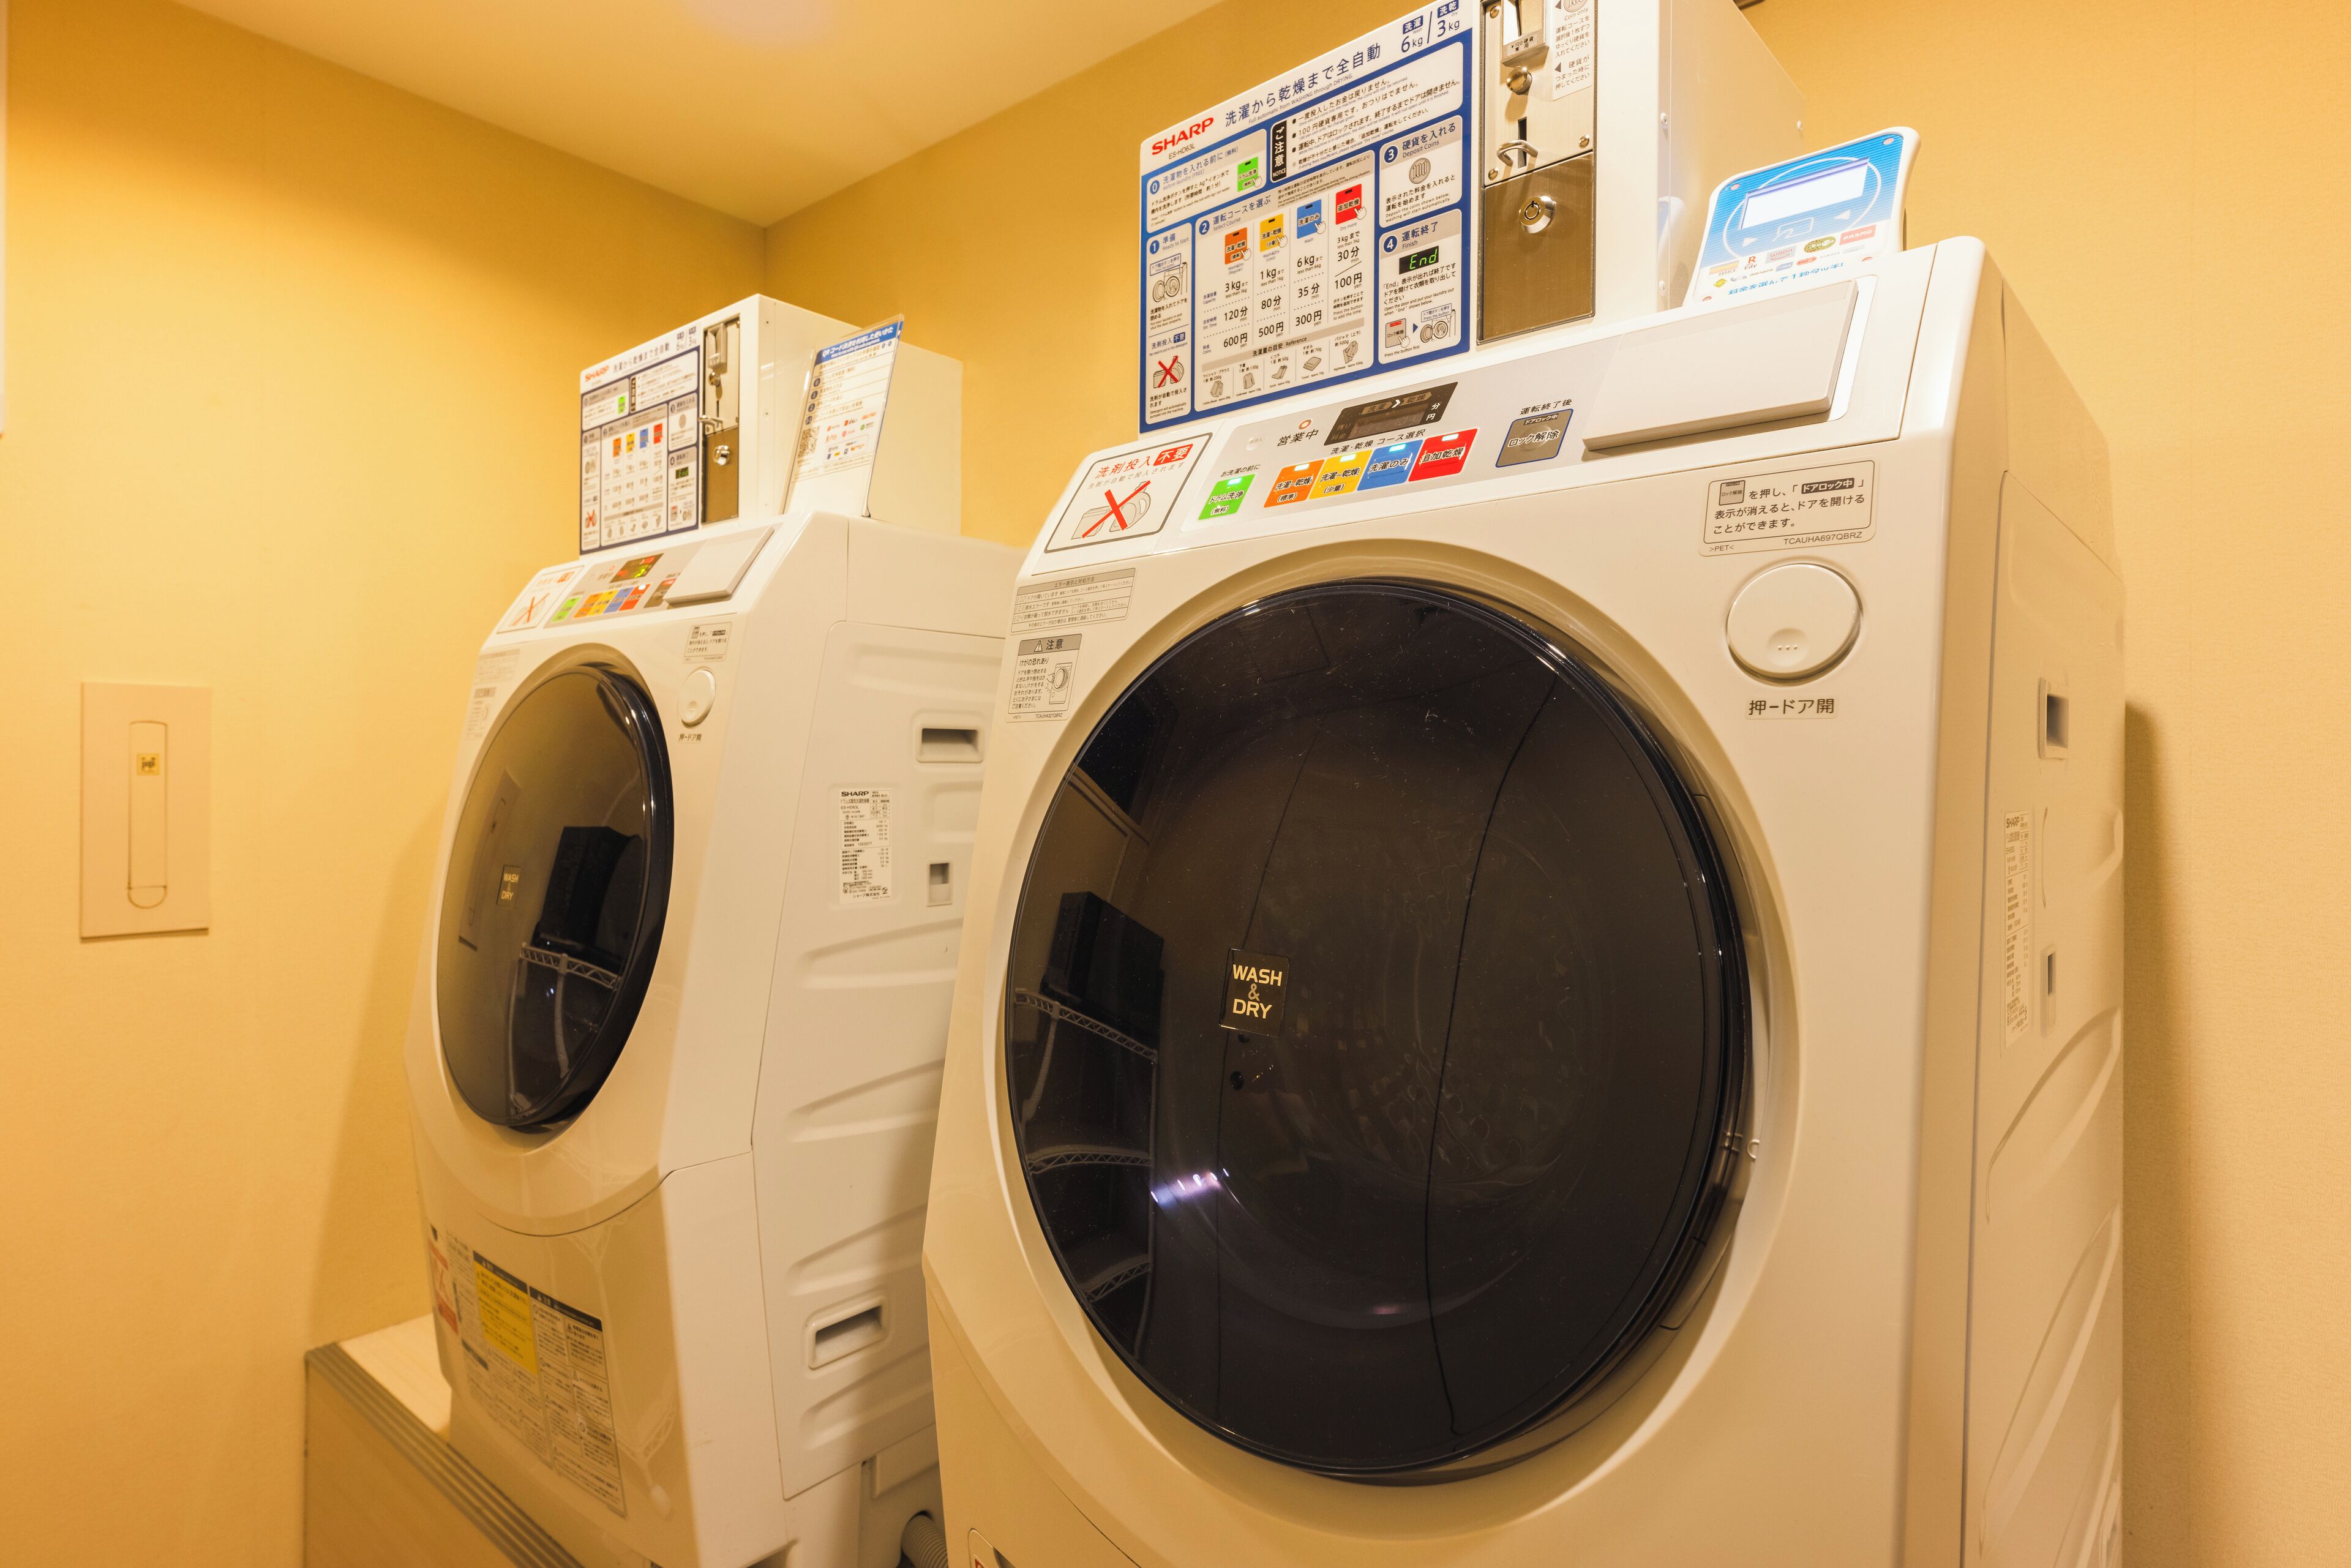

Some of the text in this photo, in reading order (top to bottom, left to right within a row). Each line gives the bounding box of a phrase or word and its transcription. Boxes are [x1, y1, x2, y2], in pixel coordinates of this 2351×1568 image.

[1577, 7, 1589, 16] only
[1404, 17, 1422, 32] 洗濯
[1556, 15, 1590, 33] 運転コースを
[1556, 40, 1590, 58] 入れてください
[1569, 54, 1590, 69] 硬貨が
[1555, 73, 1590, 90] 押してください
[1556, 65, 1590, 81] つまった時に
[1225, 43, 1381, 127] 洗濯から乾燥まで全自動
[1256, 108, 1279, 122] automatic
[1279, 102, 1291, 111] from
[1291, 92, 1313, 105] WASHING
[1314, 84, 1333, 98] through
[1152, 117, 1214, 155] SHARP
[1402, 122, 1456, 151] 硬貨を入れる
[1169, 143, 1196, 160] ES-HD63L
[1274, 126, 1284, 168] ご注意
[1403, 140, 1439, 159] Deposit Coins
[1163, 152, 1224, 184] 洗濯物を入れる前に
[1273, 168, 1286, 178] NOTICE
[1385, 174, 1456, 204] 表示された料金を入れると
[1213, 195, 1272, 225] 運転コースを選ぶ
[1338, 199, 1359, 212] 追加乾燥
[1385, 193, 1427, 212] 運転を始めます
[1385, 210, 1401, 219] Deposit
[1421, 197, 1435, 206] shown
[1213, 217, 1241, 232] Select Course
[1299, 214, 1319, 226] 洗濯のみ
[1385, 214, 1402, 223] washing
[1163, 233, 1176, 245] 準備
[1401, 221, 1439, 242] 運転終了
[1843, 230, 1872, 241] PASMO
[1402, 240, 1418, 250] Finish
[1409, 248, 1438, 271] End
[1384, 271, 1457, 298] ドアを開けて衣類を取り出して
[1384, 294, 1404, 306] ください
[1424, 294, 1433, 302] your
[1433, 290, 1447, 300] laundry
[1387, 329, 1404, 338] ロック解除
[1253, 337, 1307, 356] 洗濯量の目安 Reference
[585, 364, 610, 382] SHARP
[1520, 398, 1572, 416] 運転終了後
[1524, 413, 1559, 425] ドアロック中
[1277, 429, 1319, 447] 営業中
[1508, 430, 1560, 448] ロック解除
[1095, 446, 1191, 479] 洗剤投入 不要
[1422, 446, 1464, 463] 追加乾燥
[1220, 464, 1261, 478] お洗濯の前に
[1368, 457, 1409, 474] 洗濯のみ
[1087, 461, 1185, 490] 洗剤が自動で投入されます
[1209, 490, 1245, 504] ドラム洗浄
[1714, 494, 1865, 520] 表示が消えると、ドアを開ける
[1714, 517, 1796, 535] ことができます。
[1783, 531, 1862, 546] TCAUHA697QBRZ
[1046, 639, 1064, 651] 注意
[2006, 816, 2020, 829] SHARP
[504, 873, 519, 883] WASH
[501, 891, 514, 901] DRY
[1232, 964, 1283, 986] WASH
[1248, 983, 1260, 1002] &
[1232, 998, 1273, 1019] DRY
